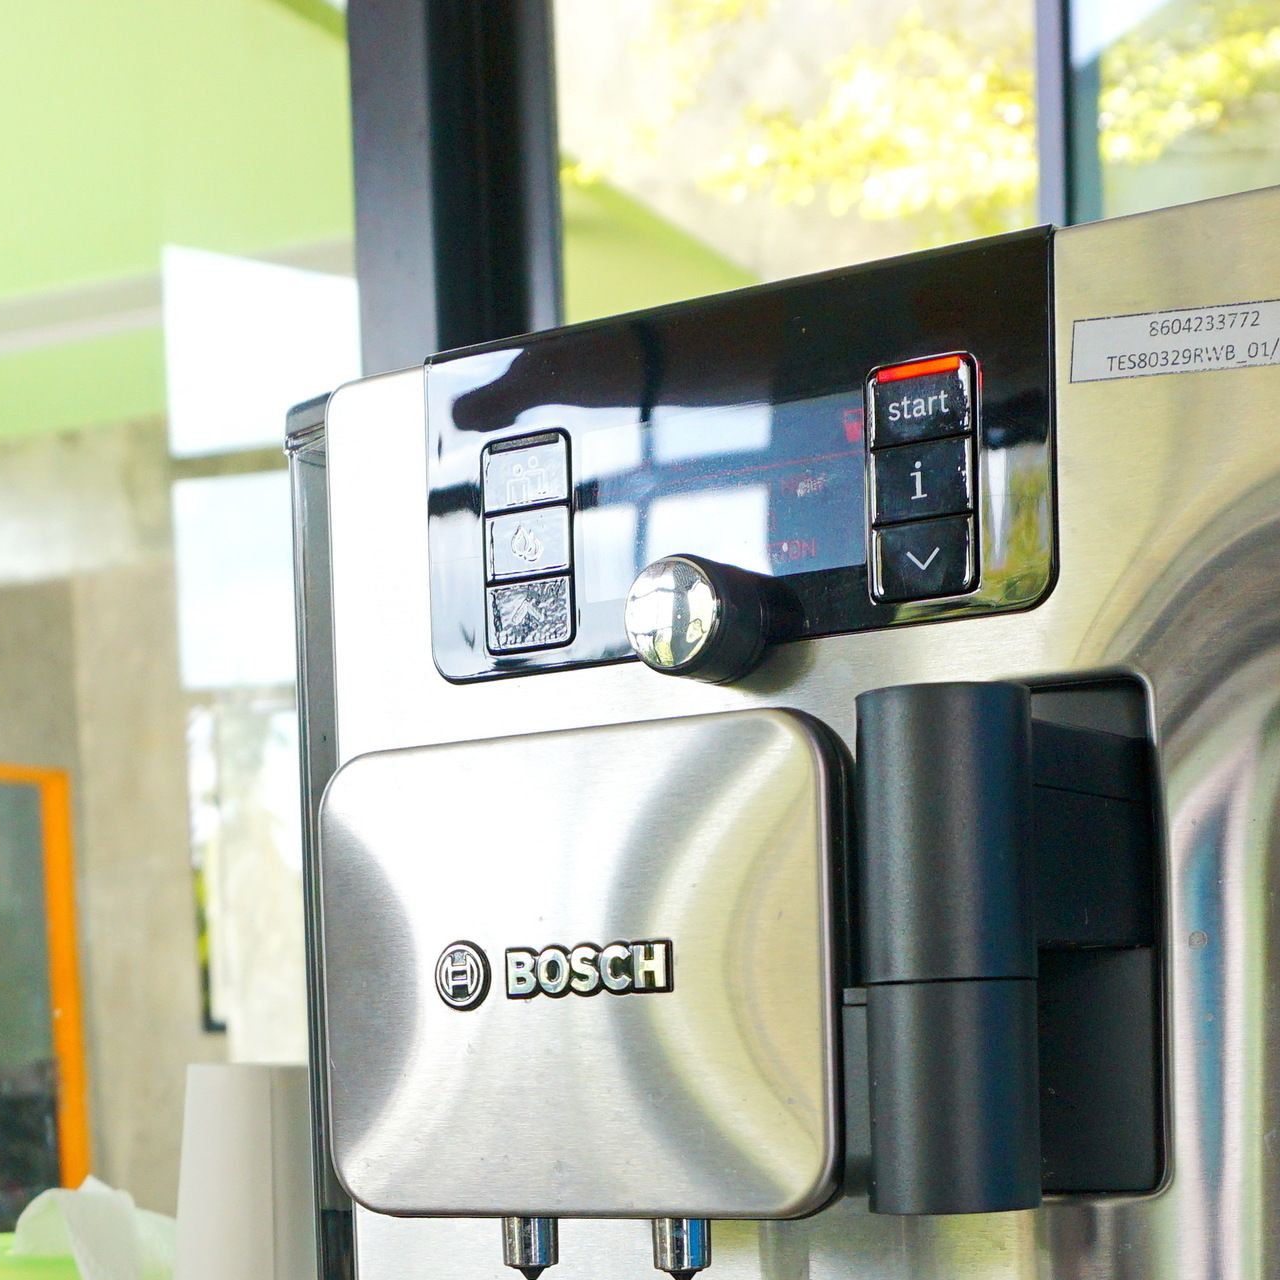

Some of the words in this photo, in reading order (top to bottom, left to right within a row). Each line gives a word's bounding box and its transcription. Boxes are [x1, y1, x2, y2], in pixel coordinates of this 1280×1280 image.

[1149, 310, 1261, 337] 8604233772
[888, 389, 950, 422] start
[506, 942, 672, 998] BOSCH
